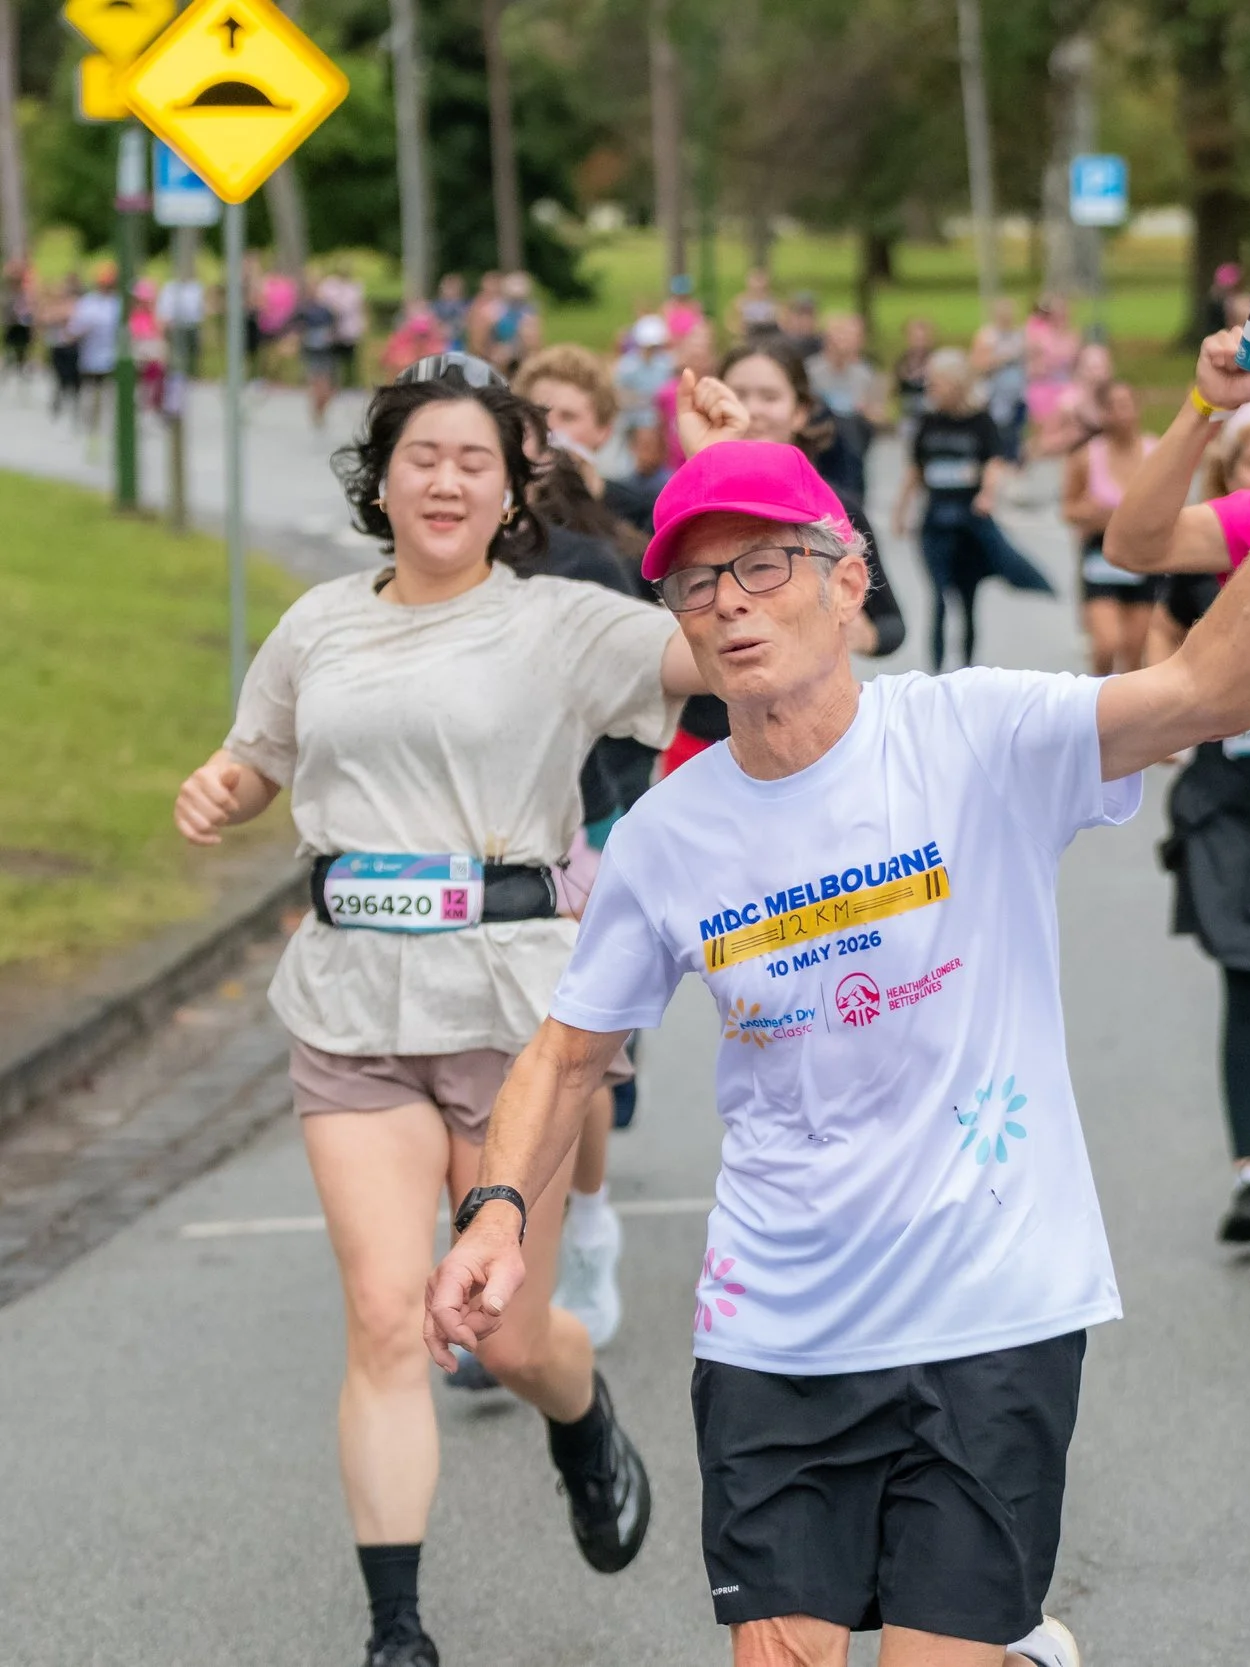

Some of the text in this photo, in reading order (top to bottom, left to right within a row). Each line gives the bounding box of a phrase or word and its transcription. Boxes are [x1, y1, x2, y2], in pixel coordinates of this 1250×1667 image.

[444, 889, 465, 905] 12
[700, 841, 943, 941] MDC MELBOURNE
[331, 895, 432, 916] 296420
[445, 909, 464, 918] KM
[780, 900, 850, 941] 12 KM
[766, 930, 882, 978] 10 MAY 2026
[888, 980, 943, 1011] BETTER LIVES
[843, 1006, 880, 1027] AIA
